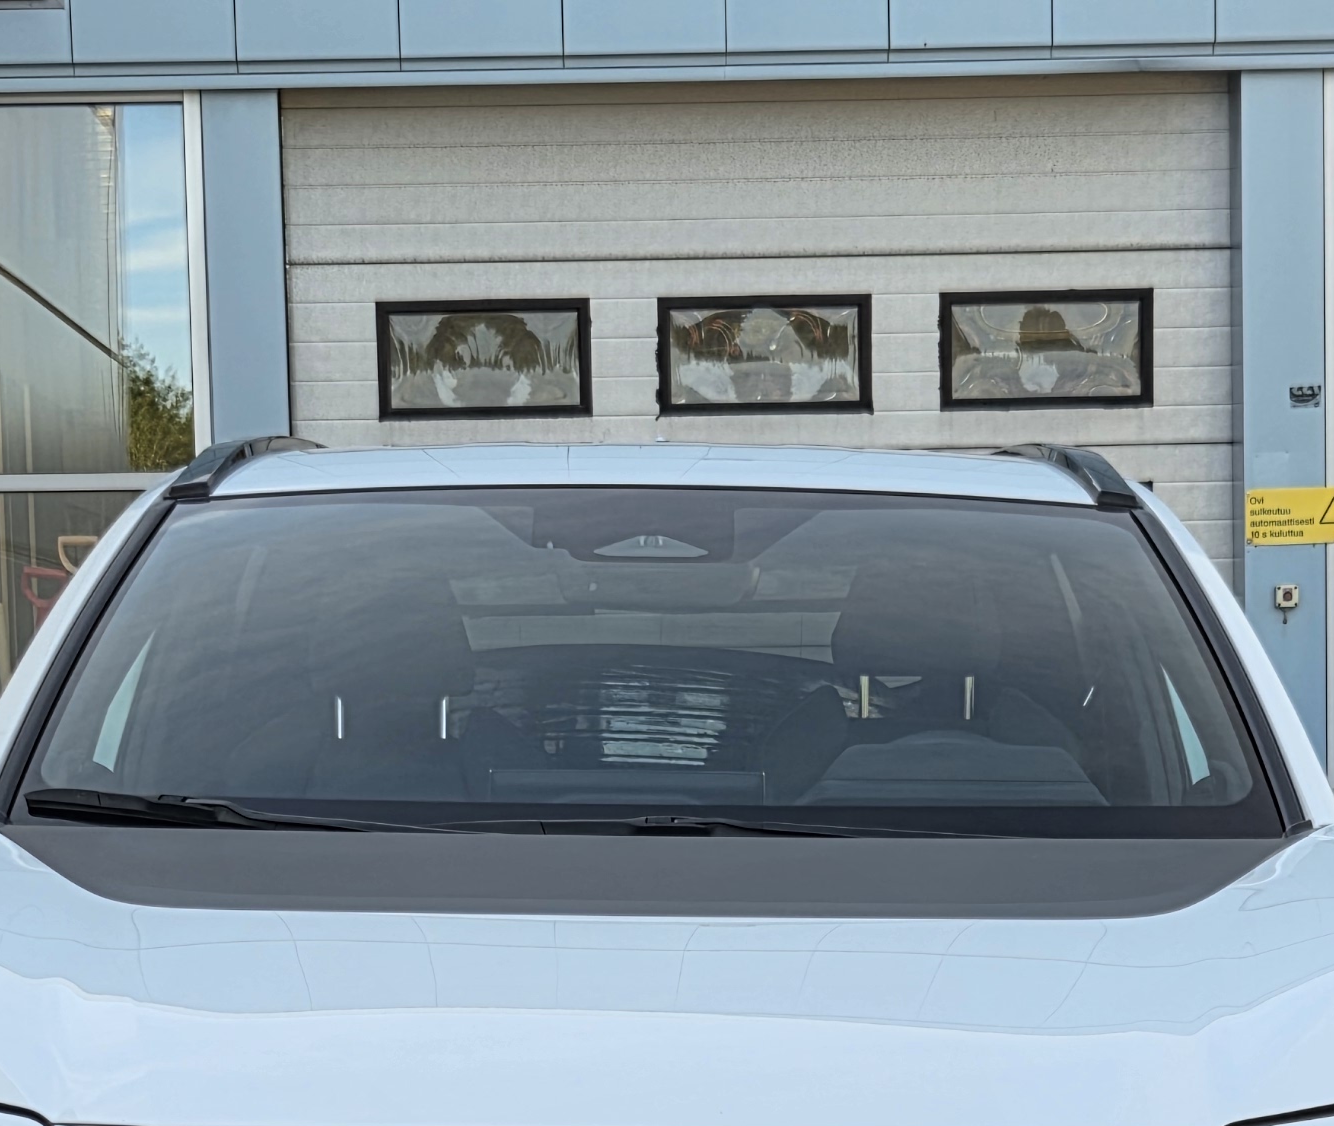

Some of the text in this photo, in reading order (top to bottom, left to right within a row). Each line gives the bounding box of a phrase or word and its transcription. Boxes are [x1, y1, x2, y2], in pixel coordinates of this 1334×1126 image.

[1249, 496, 1264, 505] Ovi
[1249, 508, 1291, 517] sulkeutuu
[1249, 517, 1315, 528] automaattisesti
[1251, 529, 1304, 539] 10 s kuluttua
